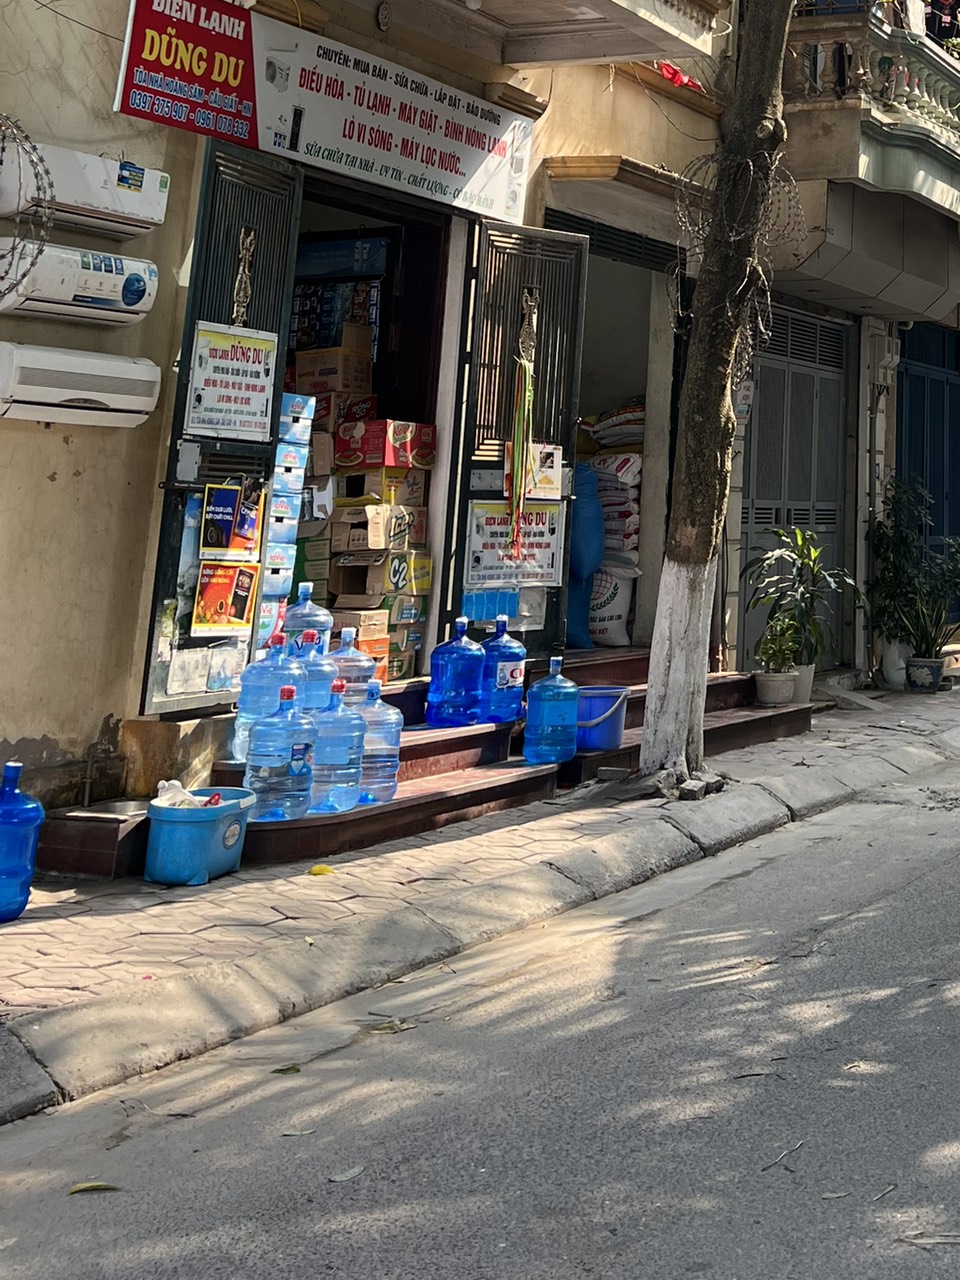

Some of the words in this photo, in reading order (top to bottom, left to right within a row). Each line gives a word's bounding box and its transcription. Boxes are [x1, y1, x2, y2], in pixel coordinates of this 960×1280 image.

[199, 7, 246, 40] LẠNH
[141, 26, 208, 76] DŨNG
[211, 51, 245, 88] DU
[316, 45, 351, 68] CHUYÊN:
[353, 58, 370, 75] MUA
[372, 64, 388, 81] BÁN
[394, 71, 409, 91] SỬA
[410, 79, 429, 98] CHỮA
[133, 65, 147, 85] TÒA
[149, 71, 163, 89] NHÀ
[129, 89, 153, 112] 0397
[153, 95, 171, 118] 375
[171, 100, 190, 122] 907
[195, 109, 216, 130] 0961
[217, 116, 233, 135] 078
[233, 121, 250, 139] 332
[298, 64, 323, 93] ĐIỀU
[324, 73, 344, 101] HÒA
[353, 81, 366, 107] TỦ
[366, 90, 392, 116] LẠNH
[398, 101, 419, 126] MÁY
[419, 108, 439, 136] GIẶT
[444, 117, 464, 143] BÌNH
[464, 125, 487, 152] NÓNG
[487, 135, 508, 159] LẠNH
[342, 115, 356, 141] LÒ
[356, 122, 366, 145] VI
[367, 123, 393, 153] SÓNG
[400, 136, 420, 161] MÁY
[421, 144, 438, 169] LỌC
[344, 152, 359, 170] TẠI
[358, 157, 376, 174] NHÀ
[379, 164, 391, 177] UY
[391, 165, 403, 182] TÍN
[252, 347, 264, 365] DU
[535, 512, 547, 526] DU
[390, 558, 409, 590] C2
